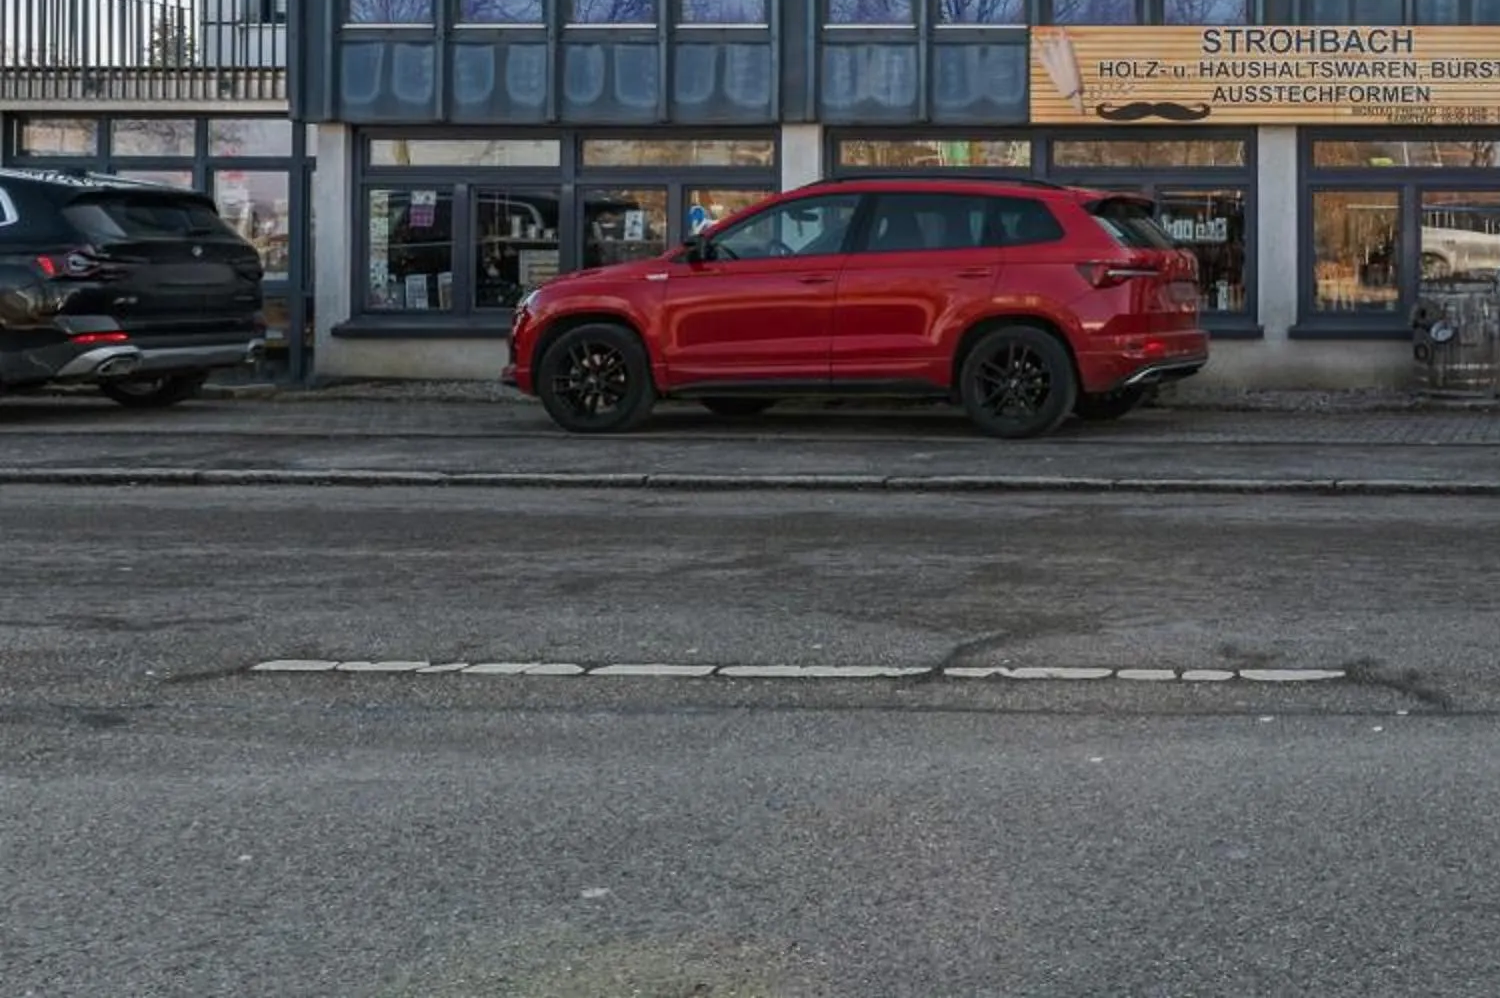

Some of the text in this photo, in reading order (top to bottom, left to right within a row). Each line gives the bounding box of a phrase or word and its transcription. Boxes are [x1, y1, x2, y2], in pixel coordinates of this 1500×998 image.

[1202, 28, 1414, 54] STROHBACH
[1099, 61, 1166, 79] HOLZ-
[1199, 61, 1424, 81] HAUSHALTSWAREN,
[1211, 85, 1431, 104] AUSSTECHFORMEN
